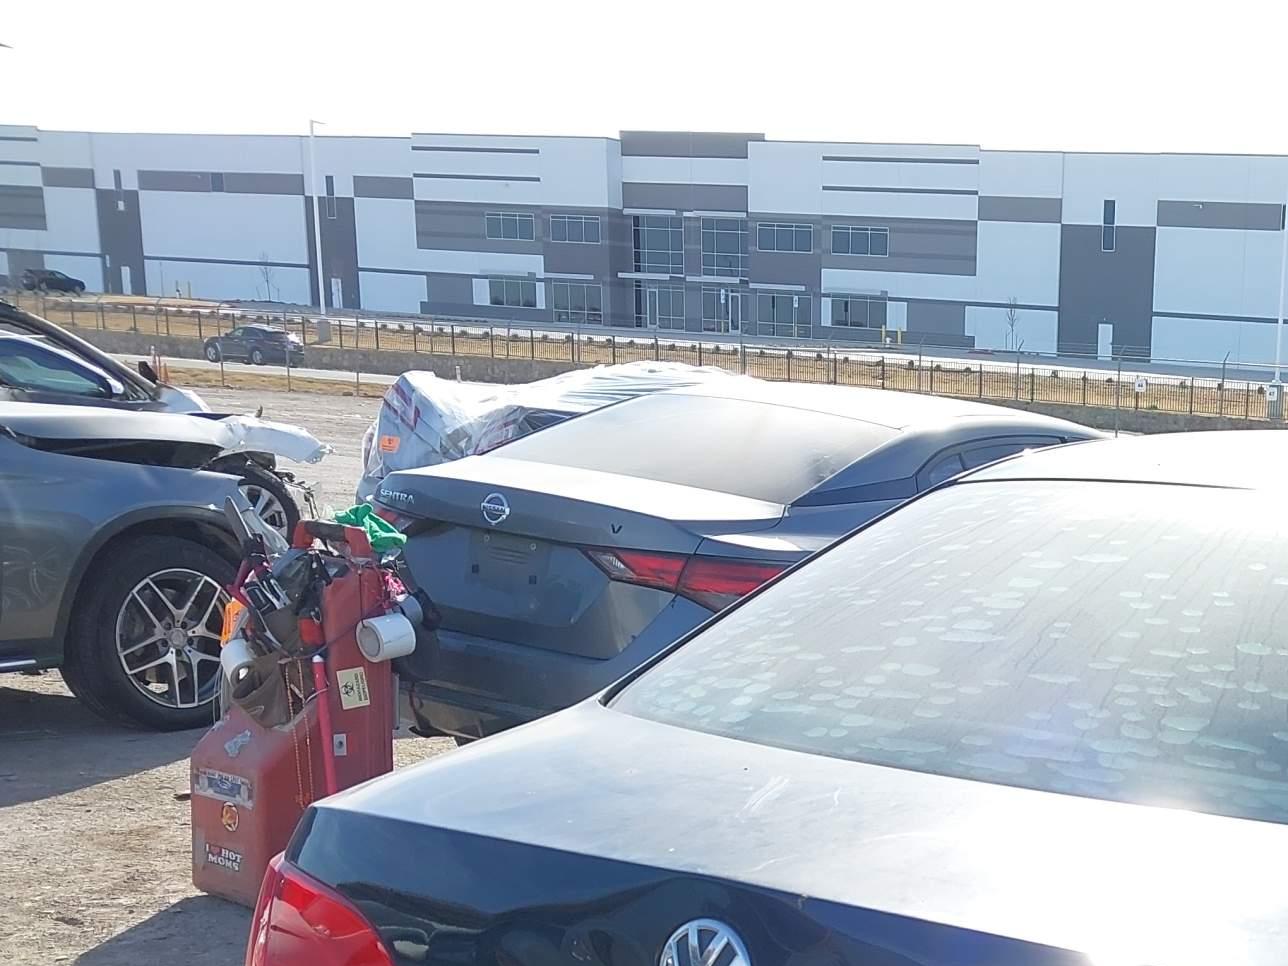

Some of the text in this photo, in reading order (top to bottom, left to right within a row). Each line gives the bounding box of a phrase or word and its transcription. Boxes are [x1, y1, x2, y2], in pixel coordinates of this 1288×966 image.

[379, 488, 415, 505] SENTRA
[610, 523, 623, 535] V
[207, 853, 239, 871] MOMS
[221, 848, 242, 863] HOT
